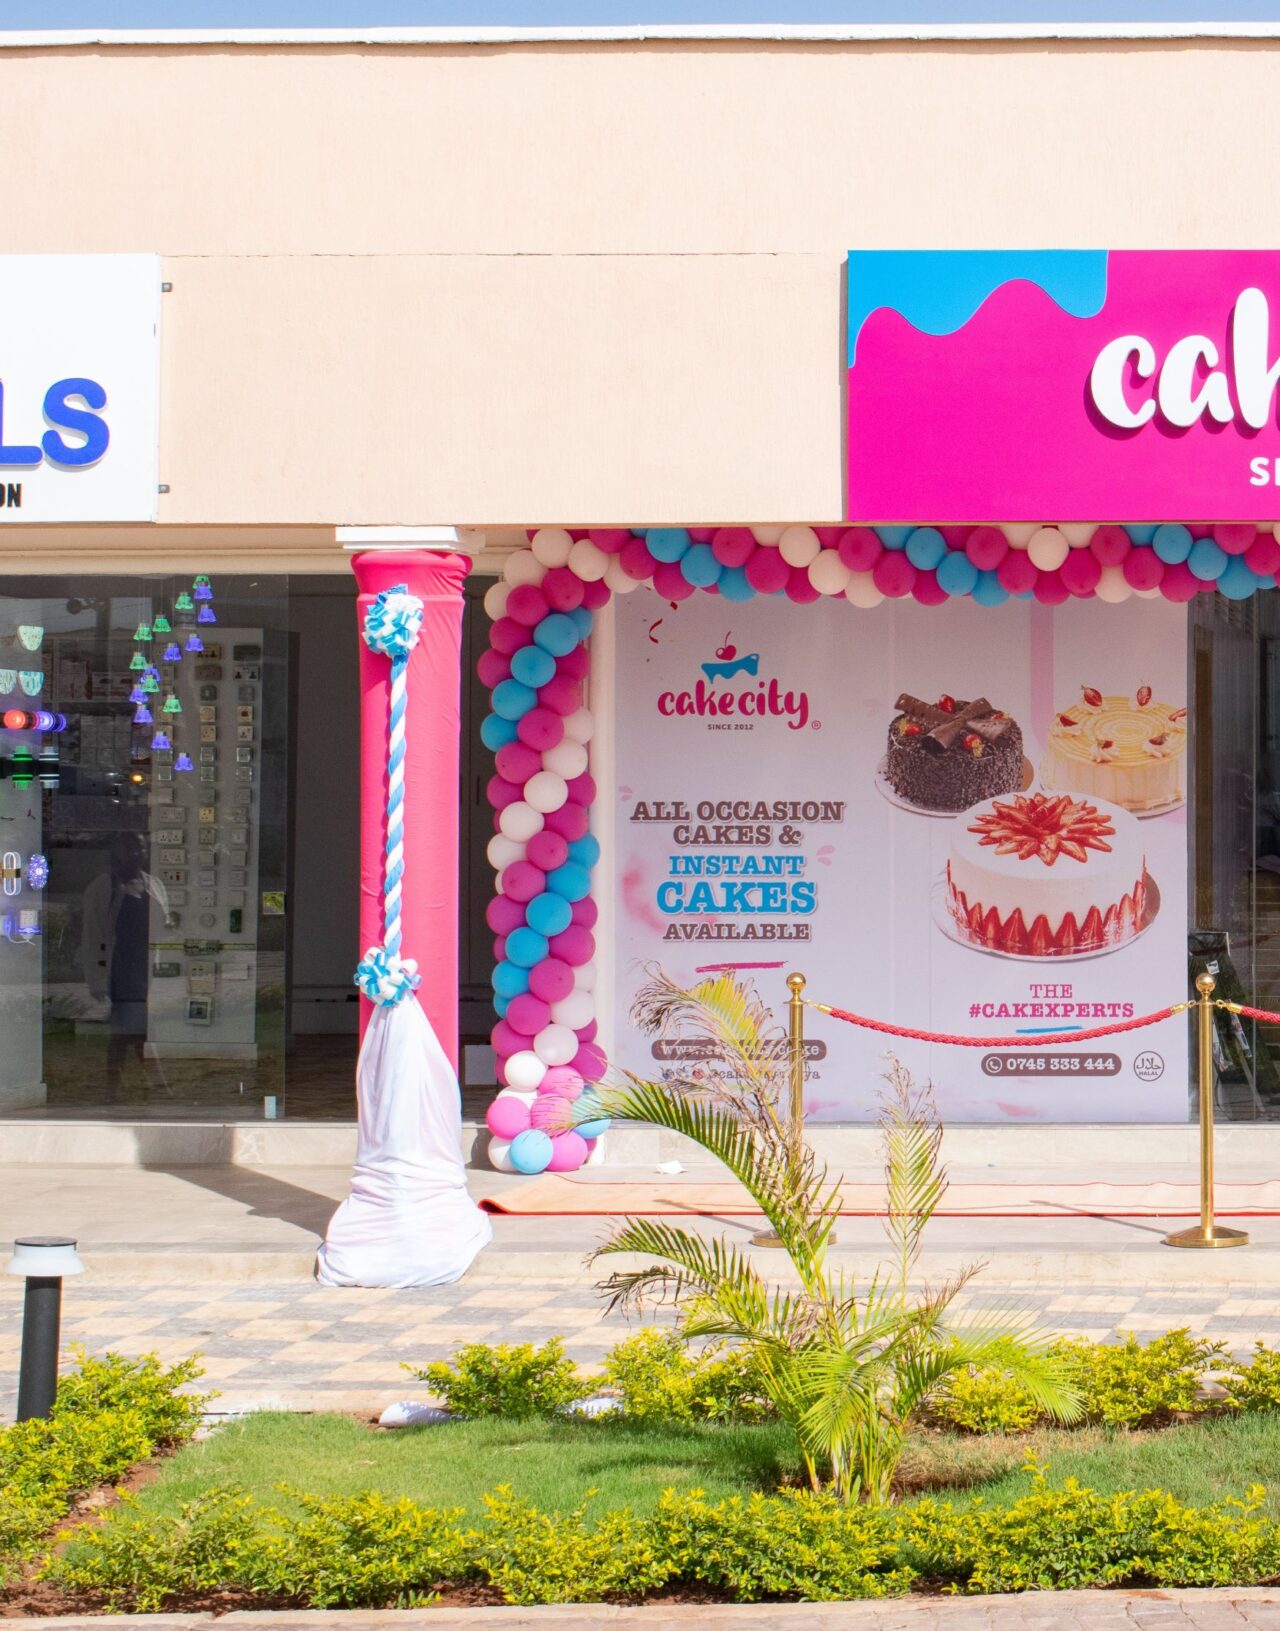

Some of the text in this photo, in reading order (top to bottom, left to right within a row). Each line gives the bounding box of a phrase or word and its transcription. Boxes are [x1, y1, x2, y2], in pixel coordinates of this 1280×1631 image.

[657, 678, 809, 730] cakecity
[707, 723, 754, 731] SINCE 2012
[630, 801, 845, 821] ALL OCCASION
[673, 825, 802, 845] CAKES &
[668, 855, 805, 875] INSTANT
[656, 881, 817, 914] CAKES
[662, 923, 810, 940] AVAILABLE
[1029, 984, 1073, 999] THE
[968, 1002, 1135, 1018] #CAKEXPERTS
[1006, 1058, 1116, 1071] 0745 333 444
[1136, 1057, 1162, 1070] حلال
